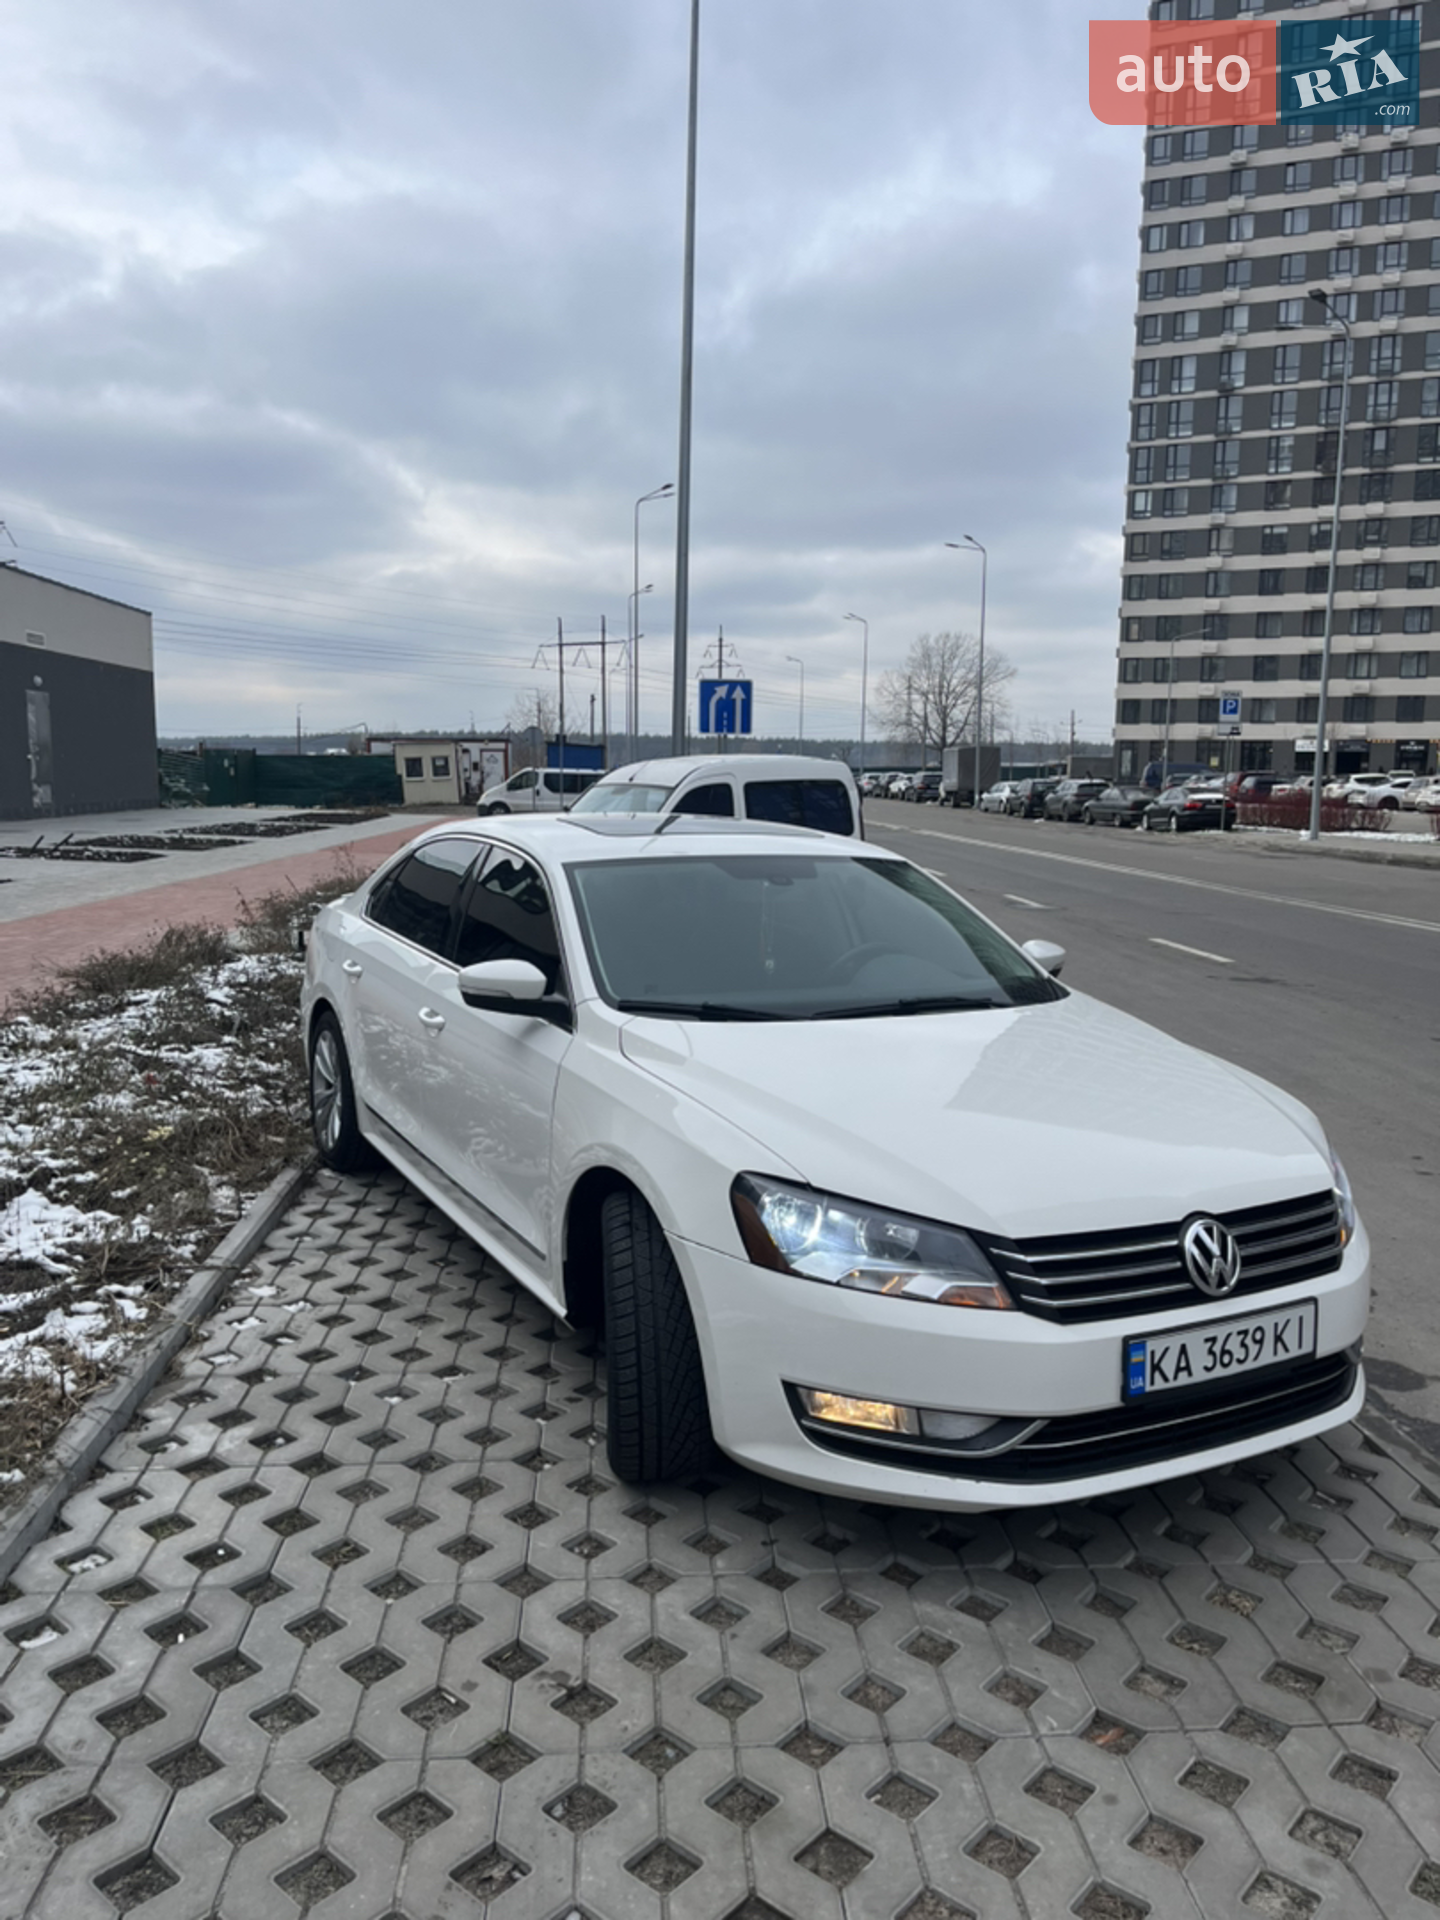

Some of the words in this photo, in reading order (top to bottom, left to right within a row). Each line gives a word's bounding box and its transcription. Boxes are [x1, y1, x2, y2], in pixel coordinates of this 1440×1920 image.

[1226, 700, 1236, 714] P
[1186, 1221, 1239, 1296] VW
[1150, 1343, 1193, 1385] KA
[1203, 1325, 1265, 1372] 3639
[1273, 1315, 1304, 1357] KI
[1130, 1376, 1145, 1389] UA
